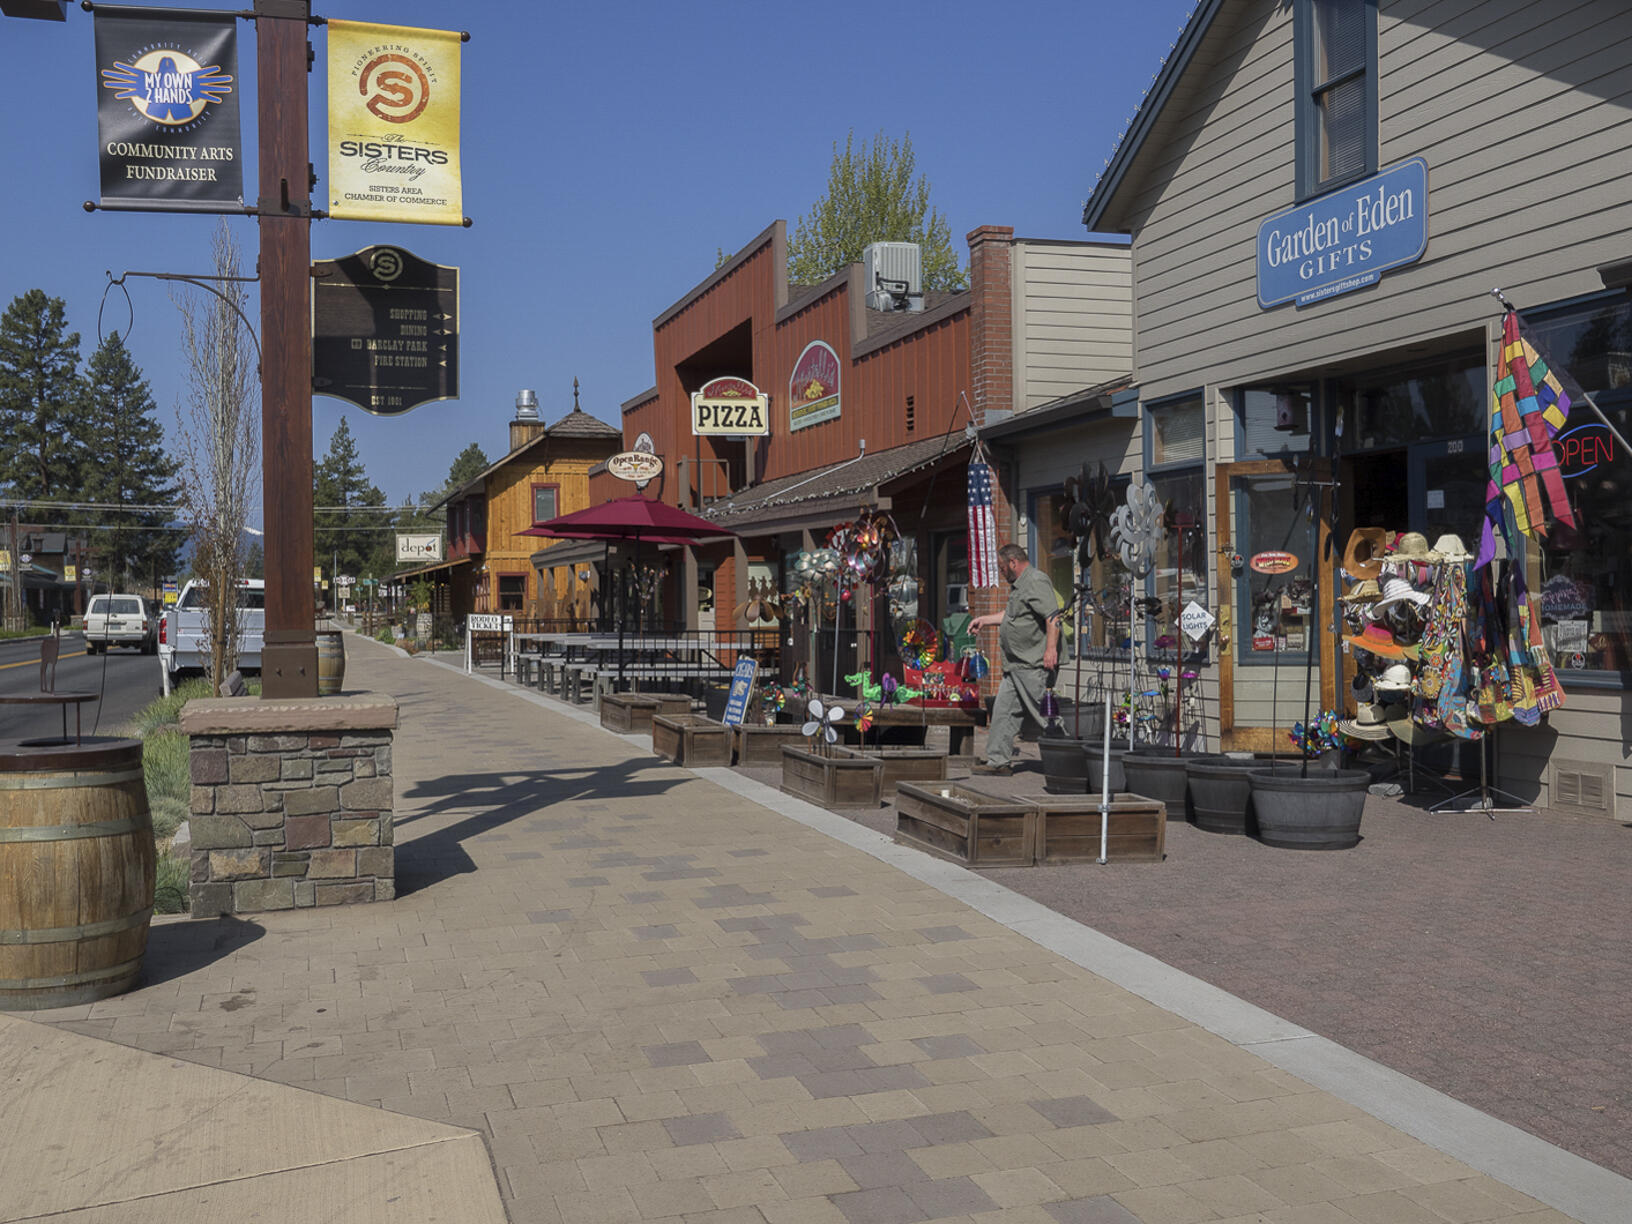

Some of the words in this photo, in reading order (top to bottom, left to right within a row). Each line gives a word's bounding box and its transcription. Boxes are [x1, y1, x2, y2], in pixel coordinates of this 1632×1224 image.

[351, 44, 410, 76] PIONEERING
[412, 51, 438, 83] SPIRIT
[144, 72, 163, 88] MY
[163, 73, 193, 89] OWN
[146, 88, 153, 103] 2
[154, 89, 193, 104] HANDS
[381, 133, 406, 143] The
[107, 142, 196, 160] COMMUNITY
[201, 146, 233, 161] ARTS
[340, 141, 448, 165] SISTERS
[126, 165, 217, 182] FUNDRAISER
[360, 157, 427, 181] Country
[369, 185, 400, 194] SISTERS
[401, 187, 423, 195] AREA
[344, 193, 385, 201] CHAMBER
[399, 196, 448, 206] COMMERCE
[1267, 213, 1340, 268] Garden
[1341, 211, 1355, 233] of
[1356, 185, 1414, 238] Eden
[1299, 240, 1373, 280] GIFTS
[1300, 273, 1375, 302] www.sistersgiftshop.com
[390, 308, 427, 321] SHOPPING
[400, 324, 427, 336] DINING
[366, 338, 404, 351] BARCLAY
[406, 340, 428, 352] PARK
[374, 355, 393, 366] FIRE
[394, 356, 427, 368] STATION
[698, 405, 763, 427] PIZZA
[1551, 434, 1614, 467] OPEN
[613, 456, 633, 466] Open
[633, 454, 658, 468] Range
[401, 537, 437, 556] depot
[1182, 612, 1207, 620] SOLAR
[1182, 621, 1208, 630] LIGHTS
